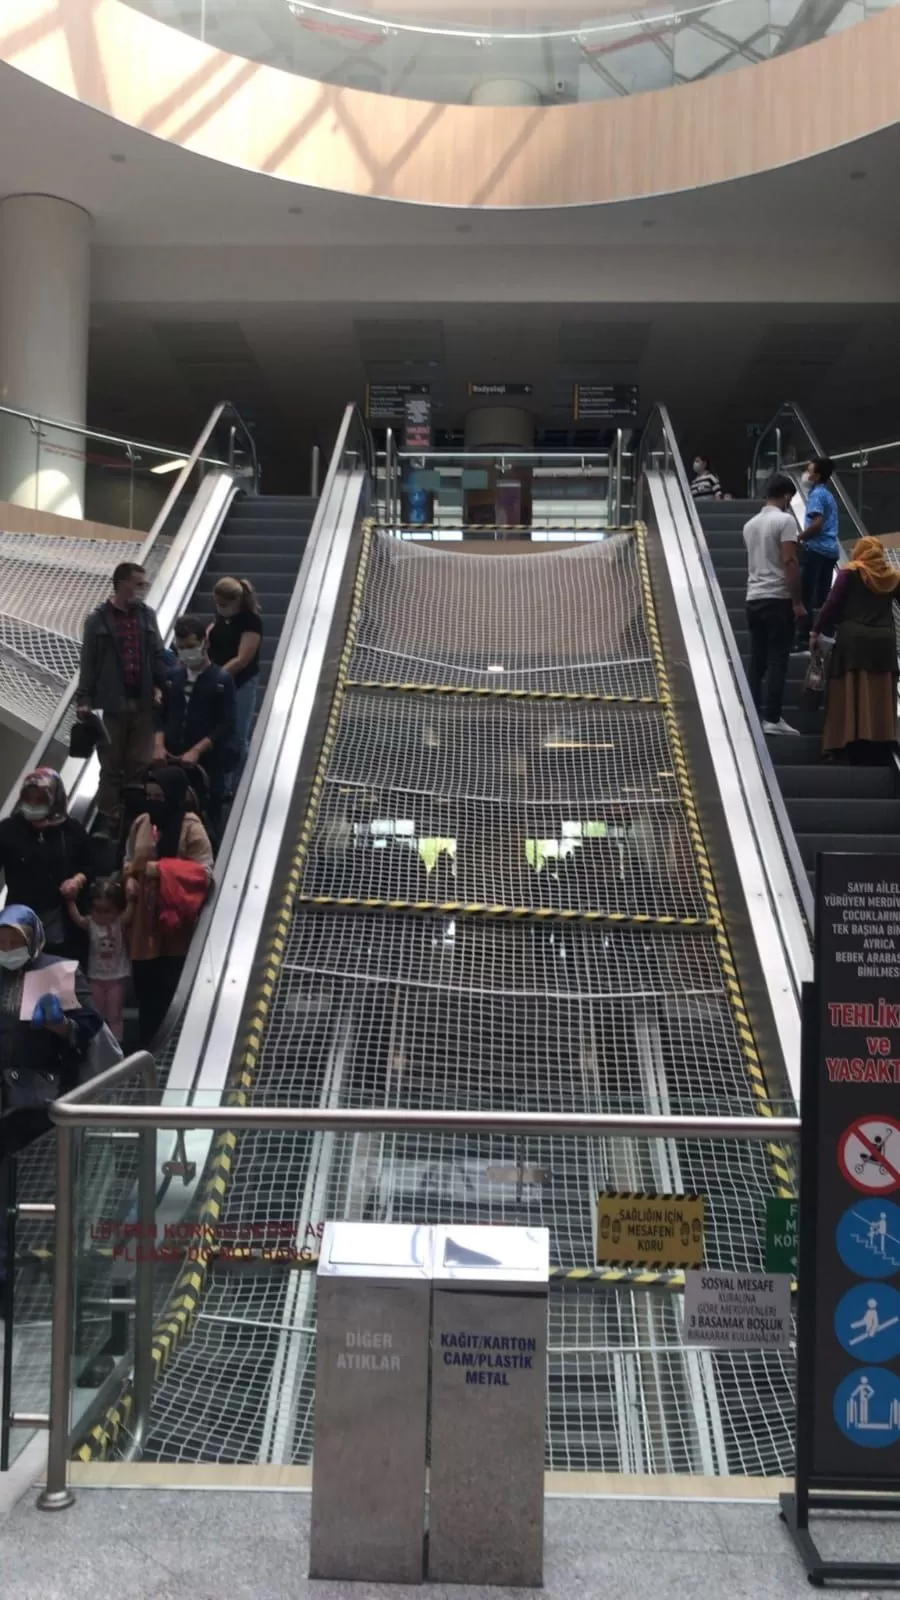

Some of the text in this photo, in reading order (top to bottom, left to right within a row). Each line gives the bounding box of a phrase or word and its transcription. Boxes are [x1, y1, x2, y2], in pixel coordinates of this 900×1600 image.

[847, 882, 874, 893] SAYIN
[824, 893, 866, 907] YÜRÜYEN
[832, 923, 849, 935] TEK
[851, 924, 885, 937] BAŞINA
[863, 938, 896, 950] AYRICA
[835, 952, 864, 963] BEBEK
[866, 1036, 892, 1057] ve
[619, 1207, 684, 1225] SAĞLIĞIN İÇİN
[627, 1223, 675, 1238] MESAFENİ
[637, 1240, 664, 1252] KORU
[701, 1277, 775, 1293] SOSYAL MESAFE
[689, 1315, 784, 1333] 3 BASAMAK BOŞLUK
[345, 1329, 394, 1349] DİĞER
[440, 1332, 537, 1351] KAĞIT/KARTON
[336, 1352, 401, 1371] ATIKLAR
[443, 1352, 533, 1369] CAM/PLASTİK
[465, 1370, 511, 1386] METAL
